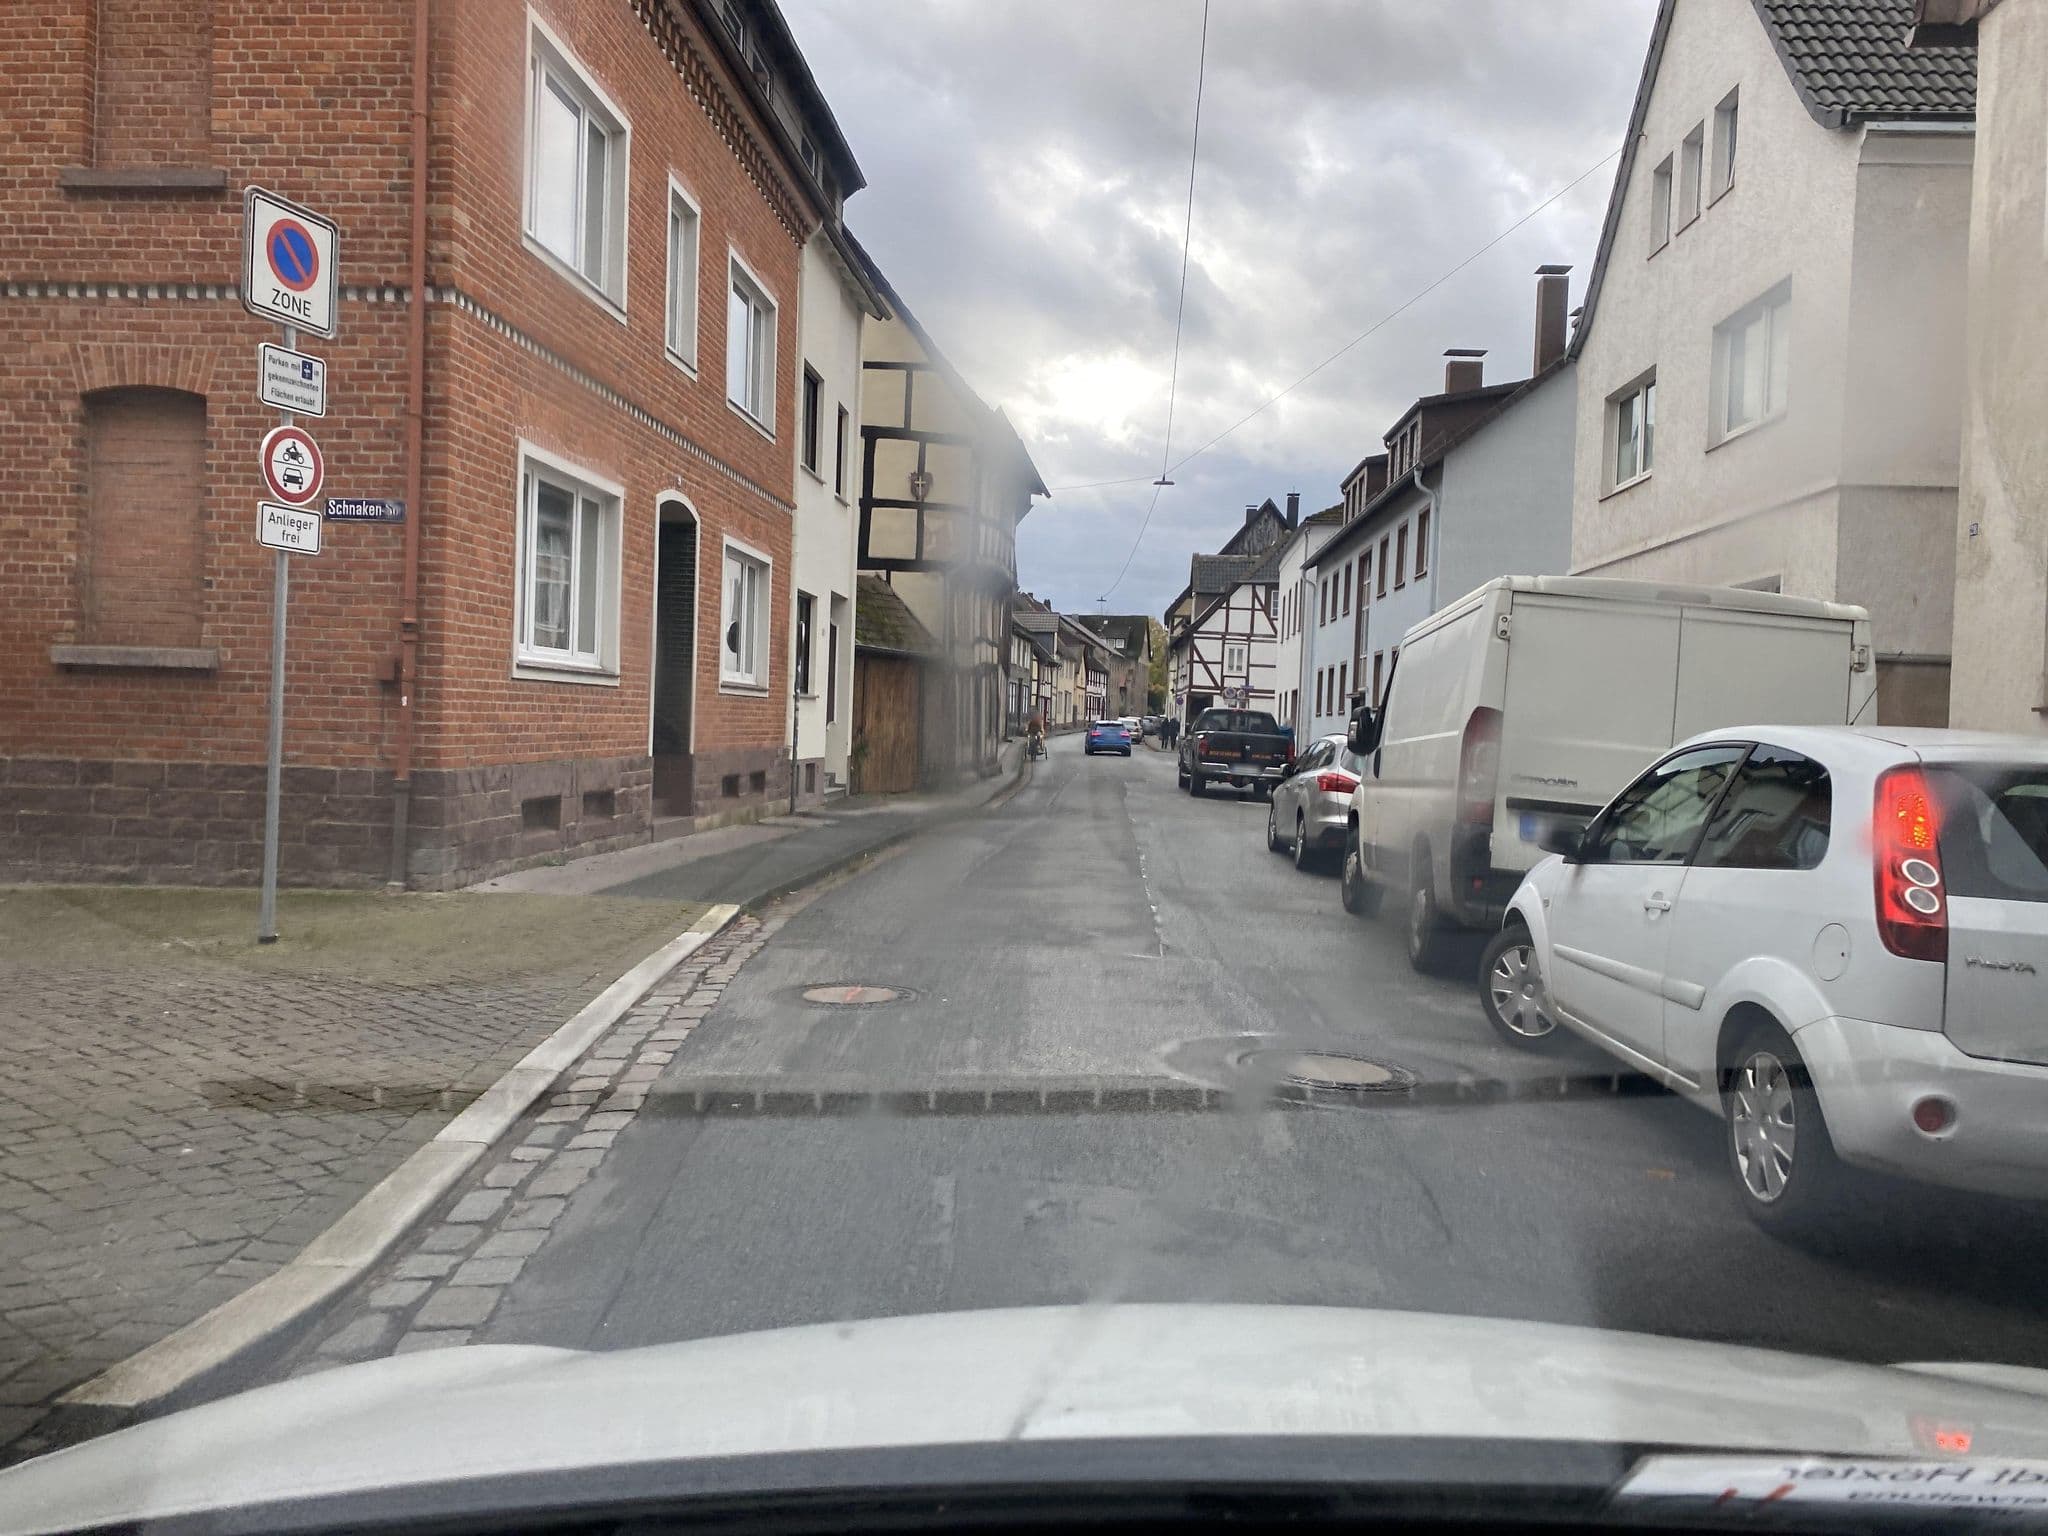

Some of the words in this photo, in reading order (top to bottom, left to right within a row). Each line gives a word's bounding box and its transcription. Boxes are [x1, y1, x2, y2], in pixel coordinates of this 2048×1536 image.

[272, 288, 311, 318] ZONE
[268, 354, 289, 368] Parken
[295, 395, 315, 406] erlaubt
[268, 512, 313, 531] Anlieger
[282, 530, 300, 543] frei
